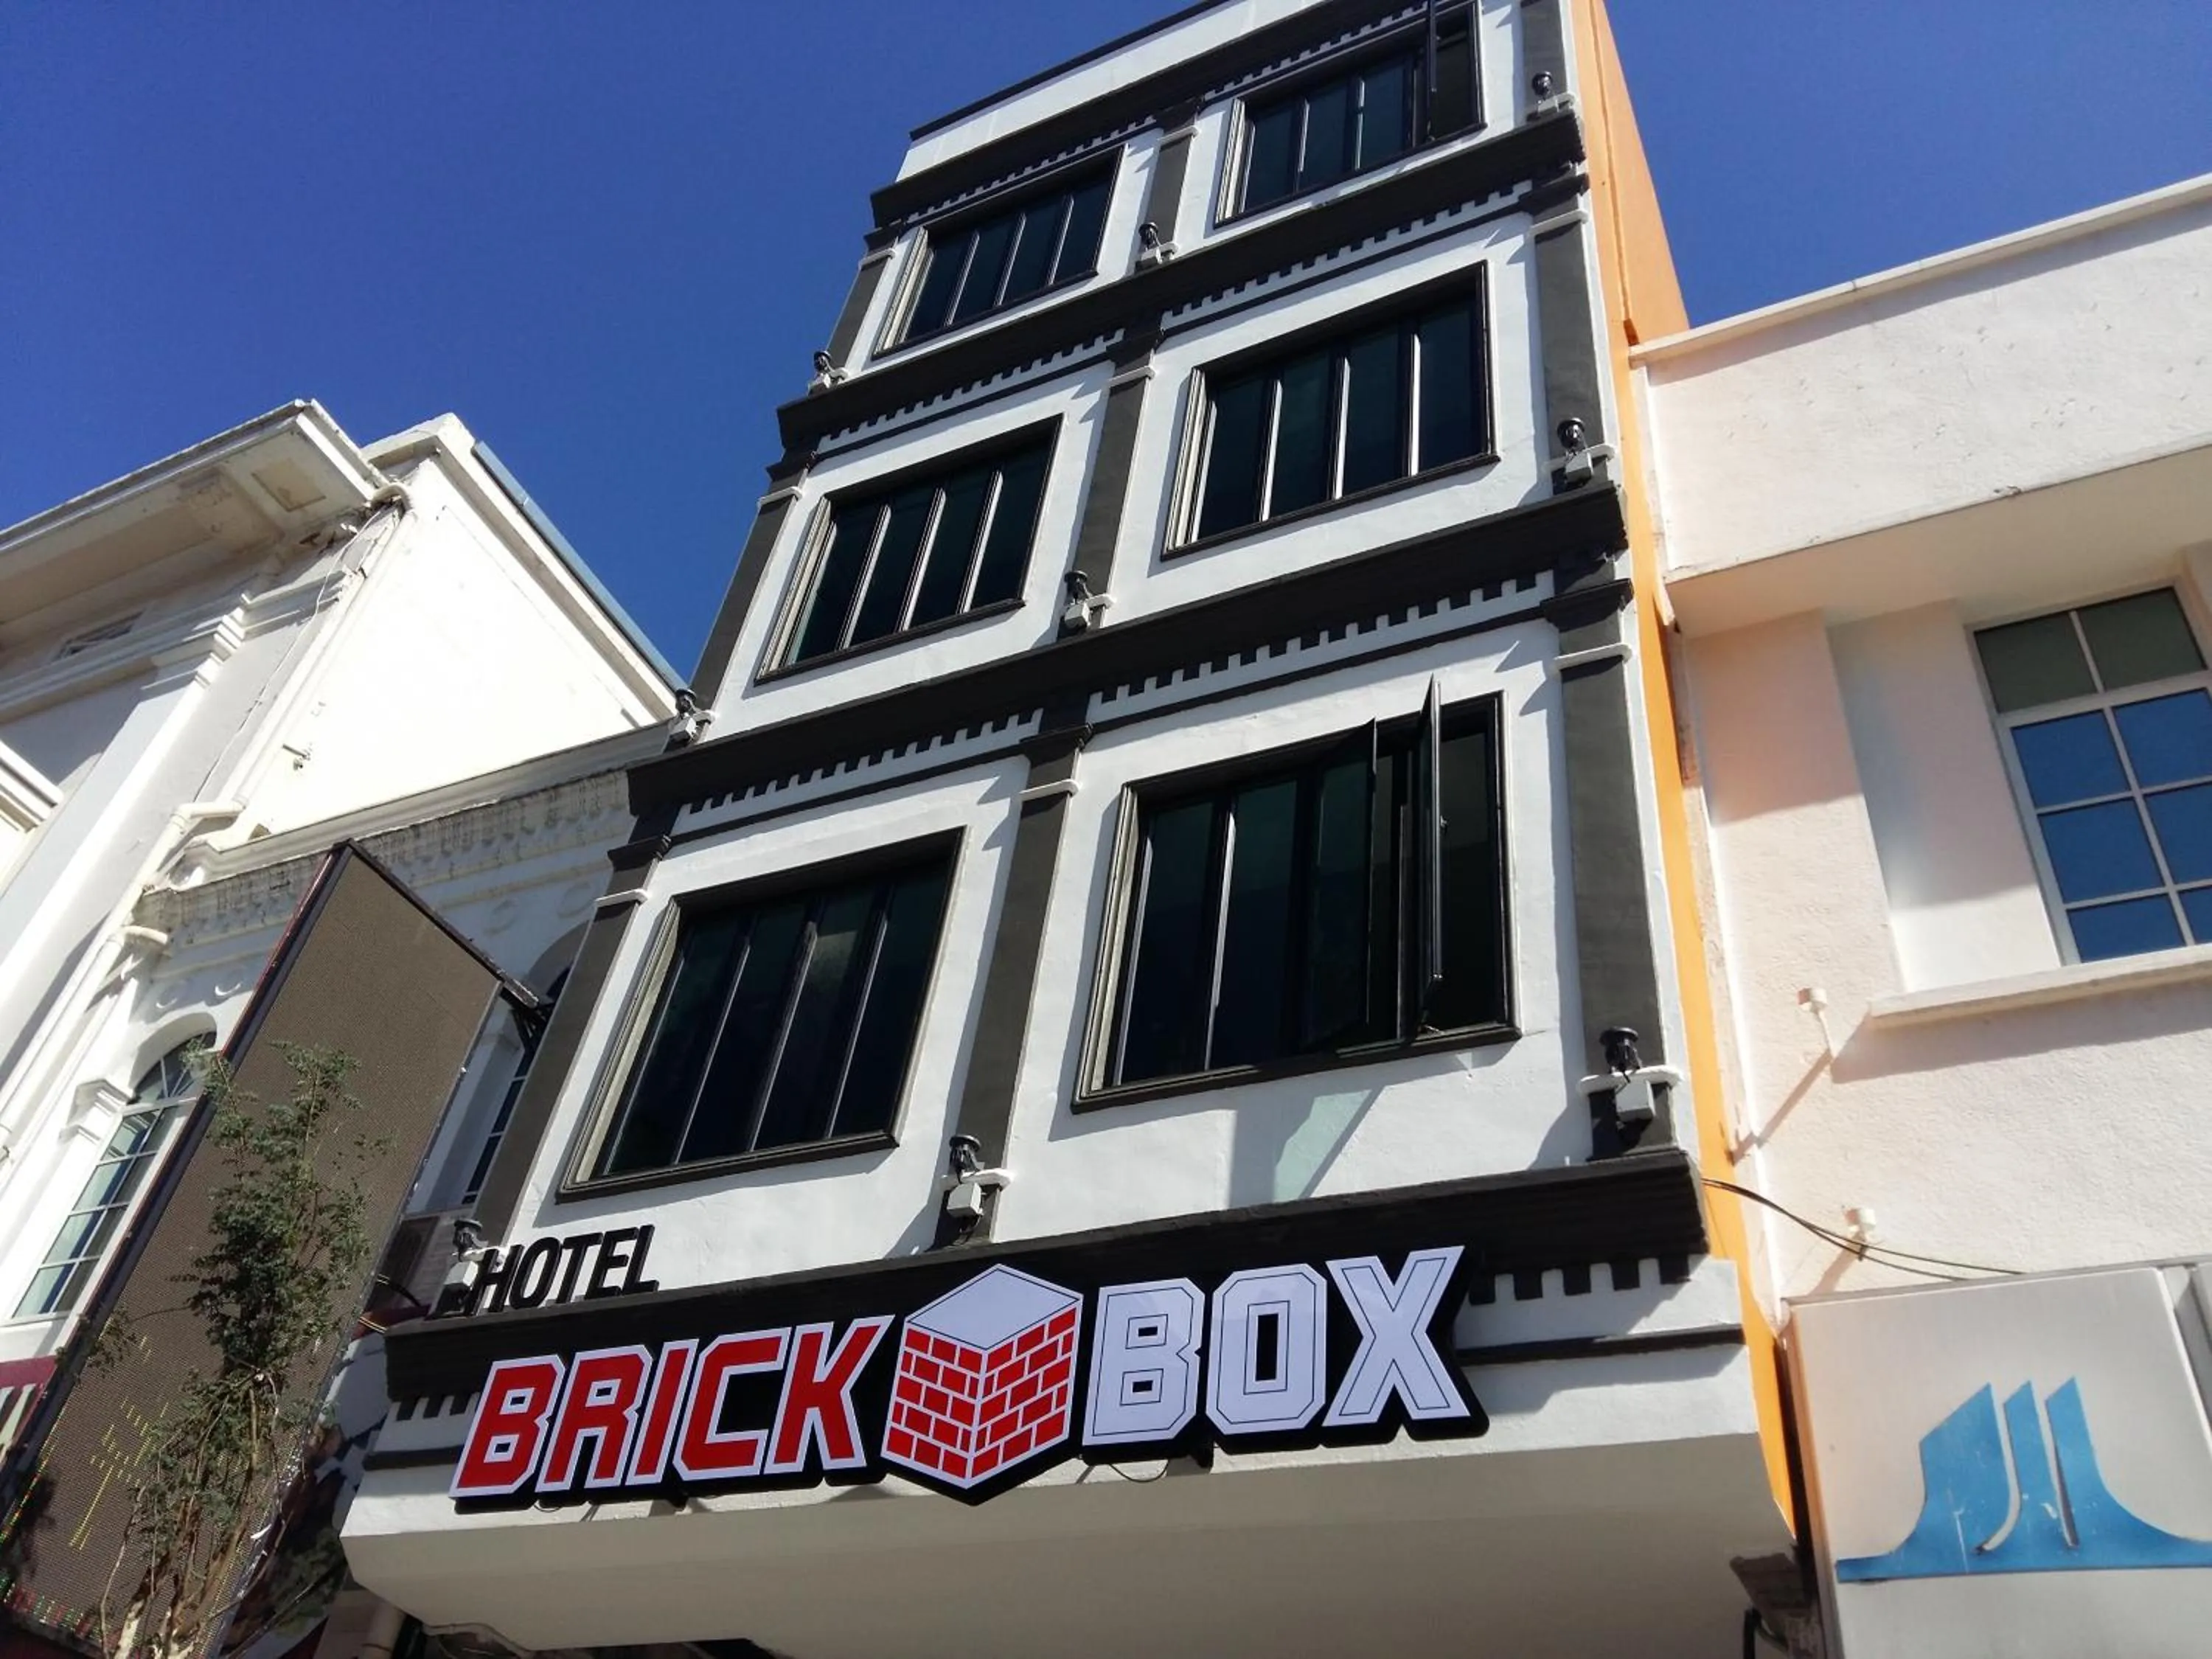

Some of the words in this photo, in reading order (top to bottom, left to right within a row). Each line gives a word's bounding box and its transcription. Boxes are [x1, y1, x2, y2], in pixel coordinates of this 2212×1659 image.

[465, 1225, 658, 1317] HOTEL
[448, 1315, 895, 1499] BRICK
[1082, 1245, 1470, 1446] BOX
